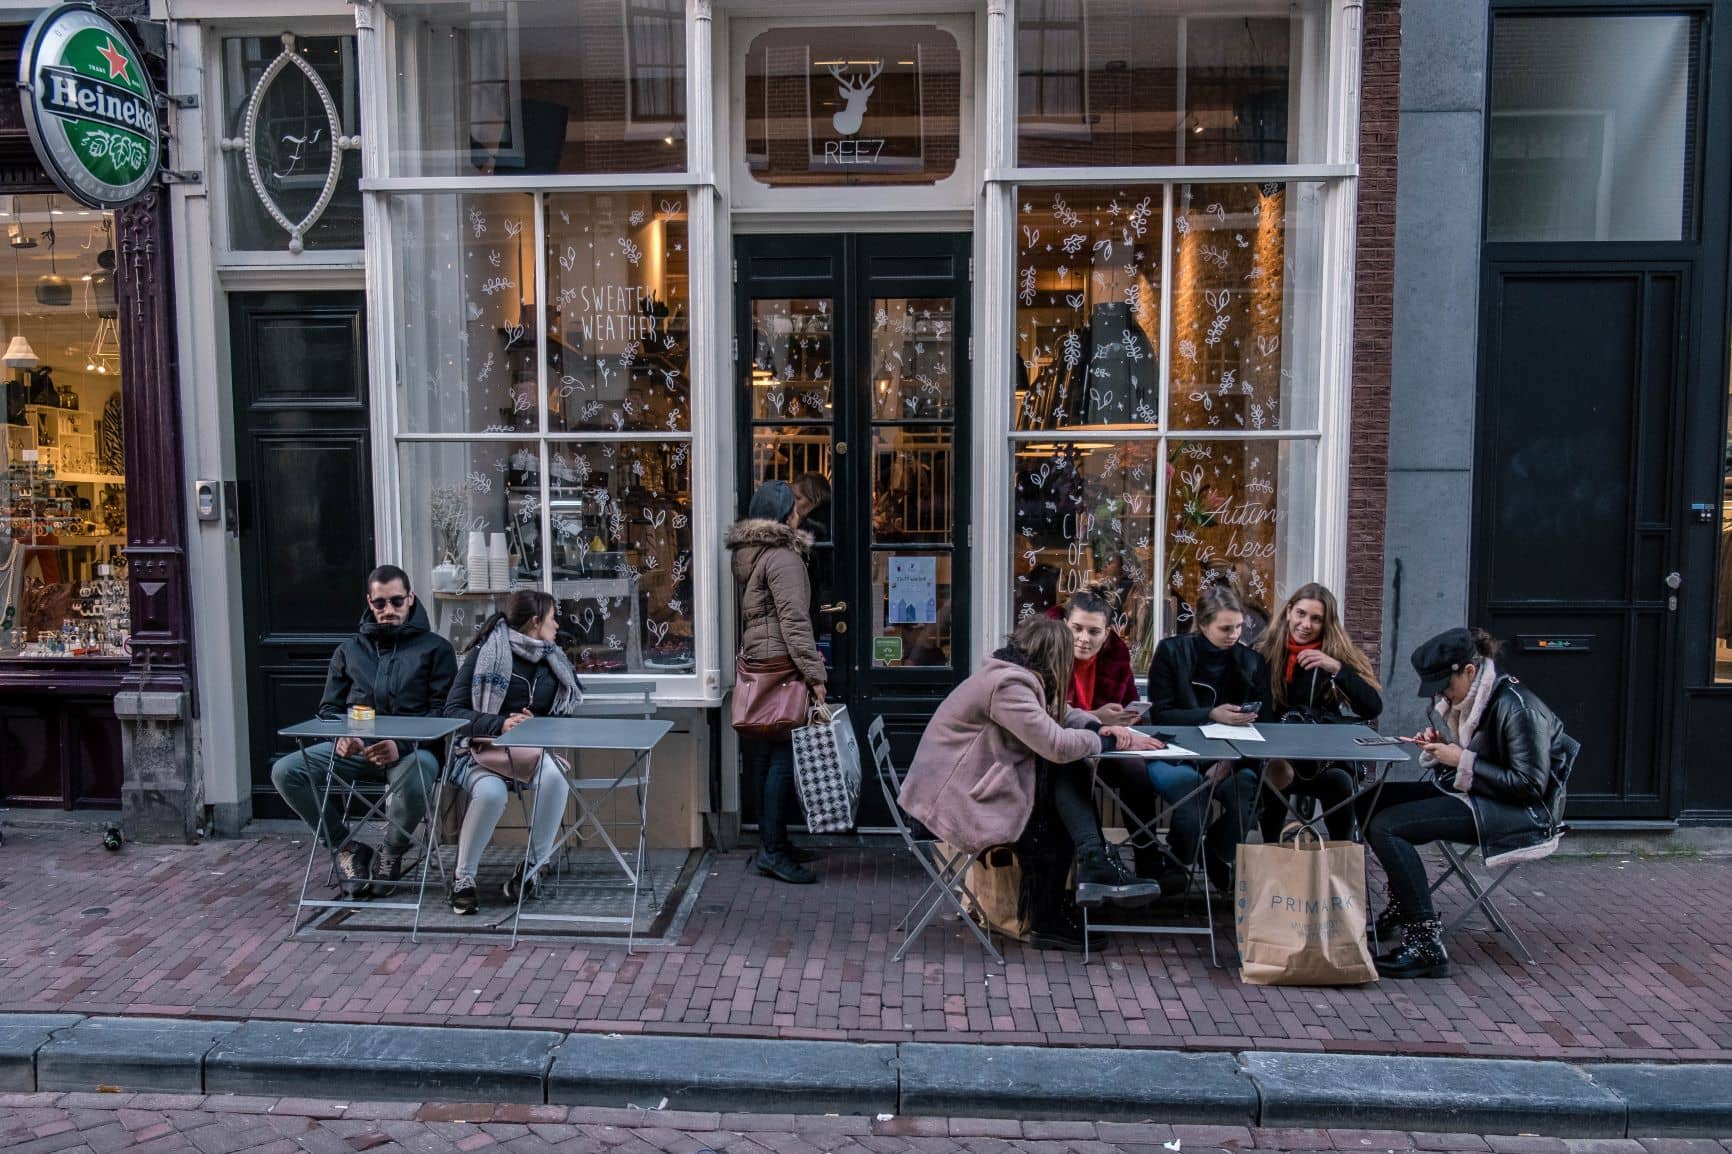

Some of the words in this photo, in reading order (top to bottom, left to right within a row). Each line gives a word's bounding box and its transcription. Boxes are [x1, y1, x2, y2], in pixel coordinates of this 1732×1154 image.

[581, 285, 655, 313] SWEATER
[581, 314, 657, 343] WEATHER
[1062, 513, 1095, 539] CUP
[1068, 542, 1089, 566] OF
[1195, 540, 1216, 563] is
[1224, 529, 1278, 558] here
[1270, 895, 1353, 915] PRIMARK
